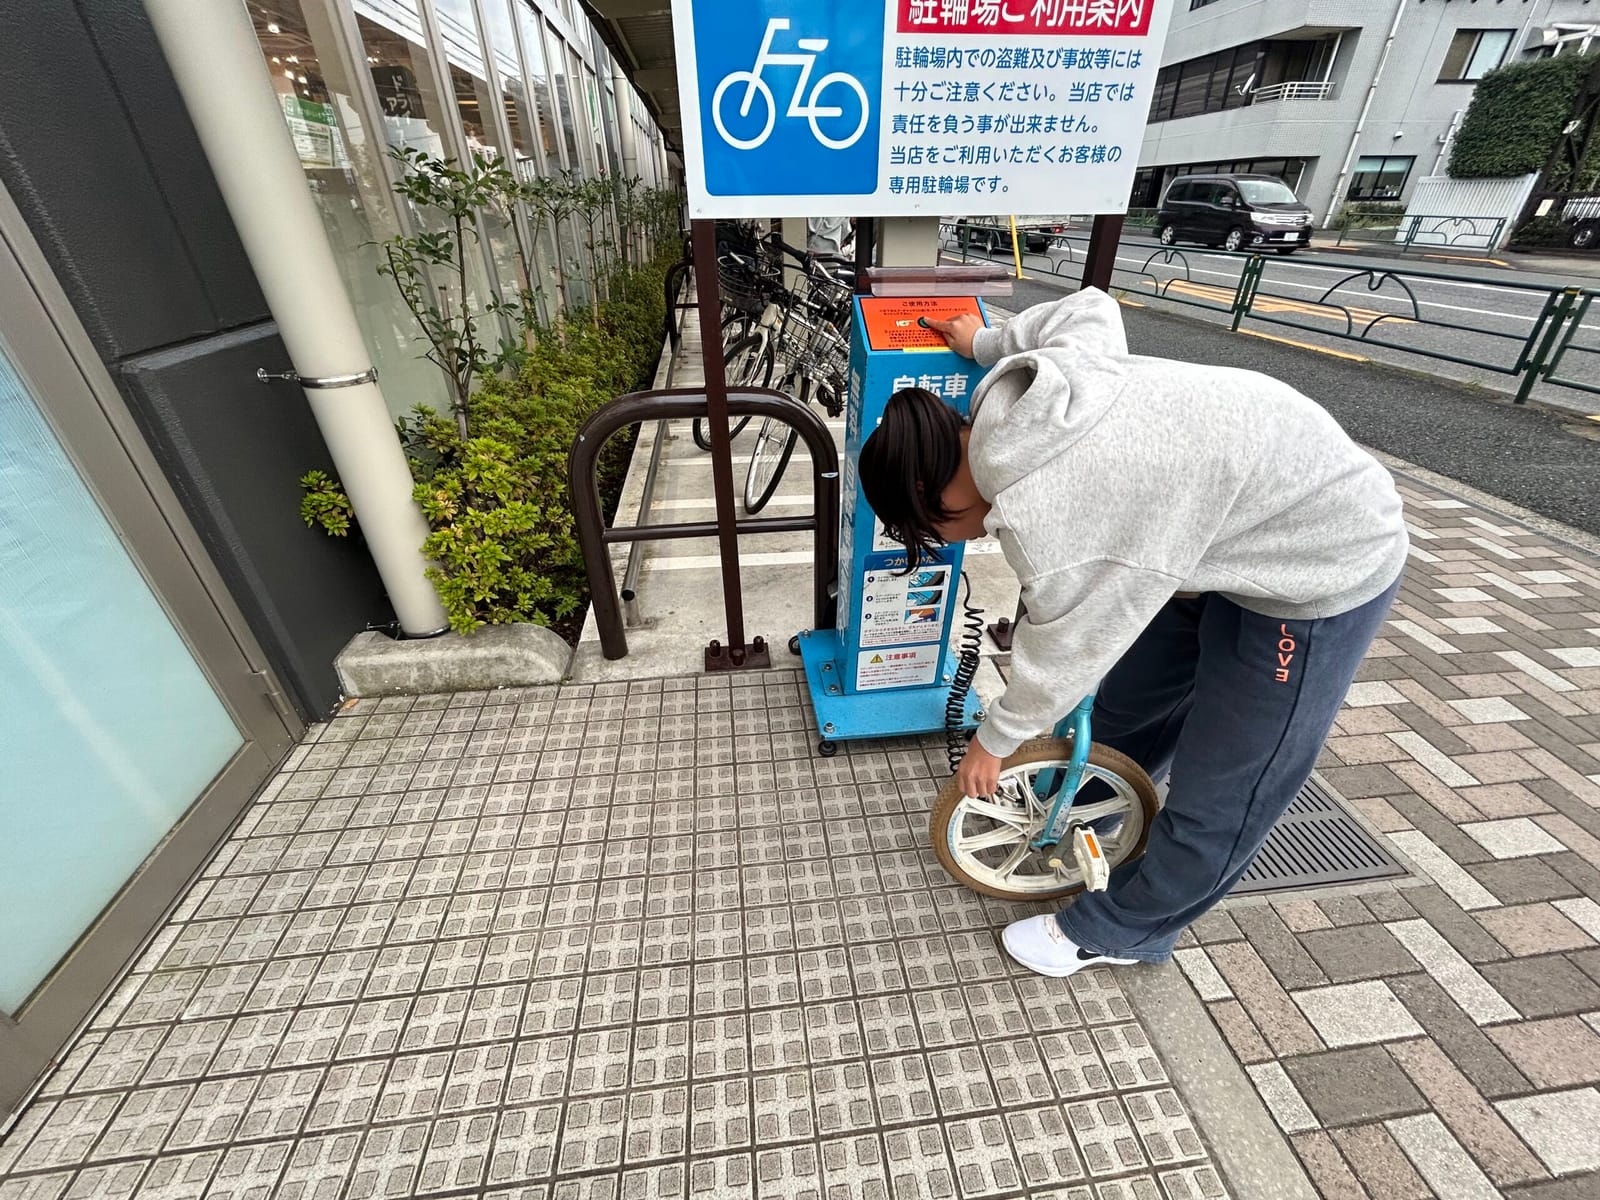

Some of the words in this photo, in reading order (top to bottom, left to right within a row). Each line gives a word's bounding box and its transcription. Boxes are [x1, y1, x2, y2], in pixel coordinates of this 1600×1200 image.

[895, 46, 1142, 70] 駐輪場内での盗難及び事故等には
[892, 114, 1099, 135] 責任を負う事が出来ません。
[889, 145, 1122, 165] 当店をご利用いただくお客様の
[888, 175, 1010, 195] 専用駐輪場です。
[893, 373, 969, 398] 自転車
[884, 651, 917, 661] 注意事項
[1275, 623, 1296, 682] LOVE
